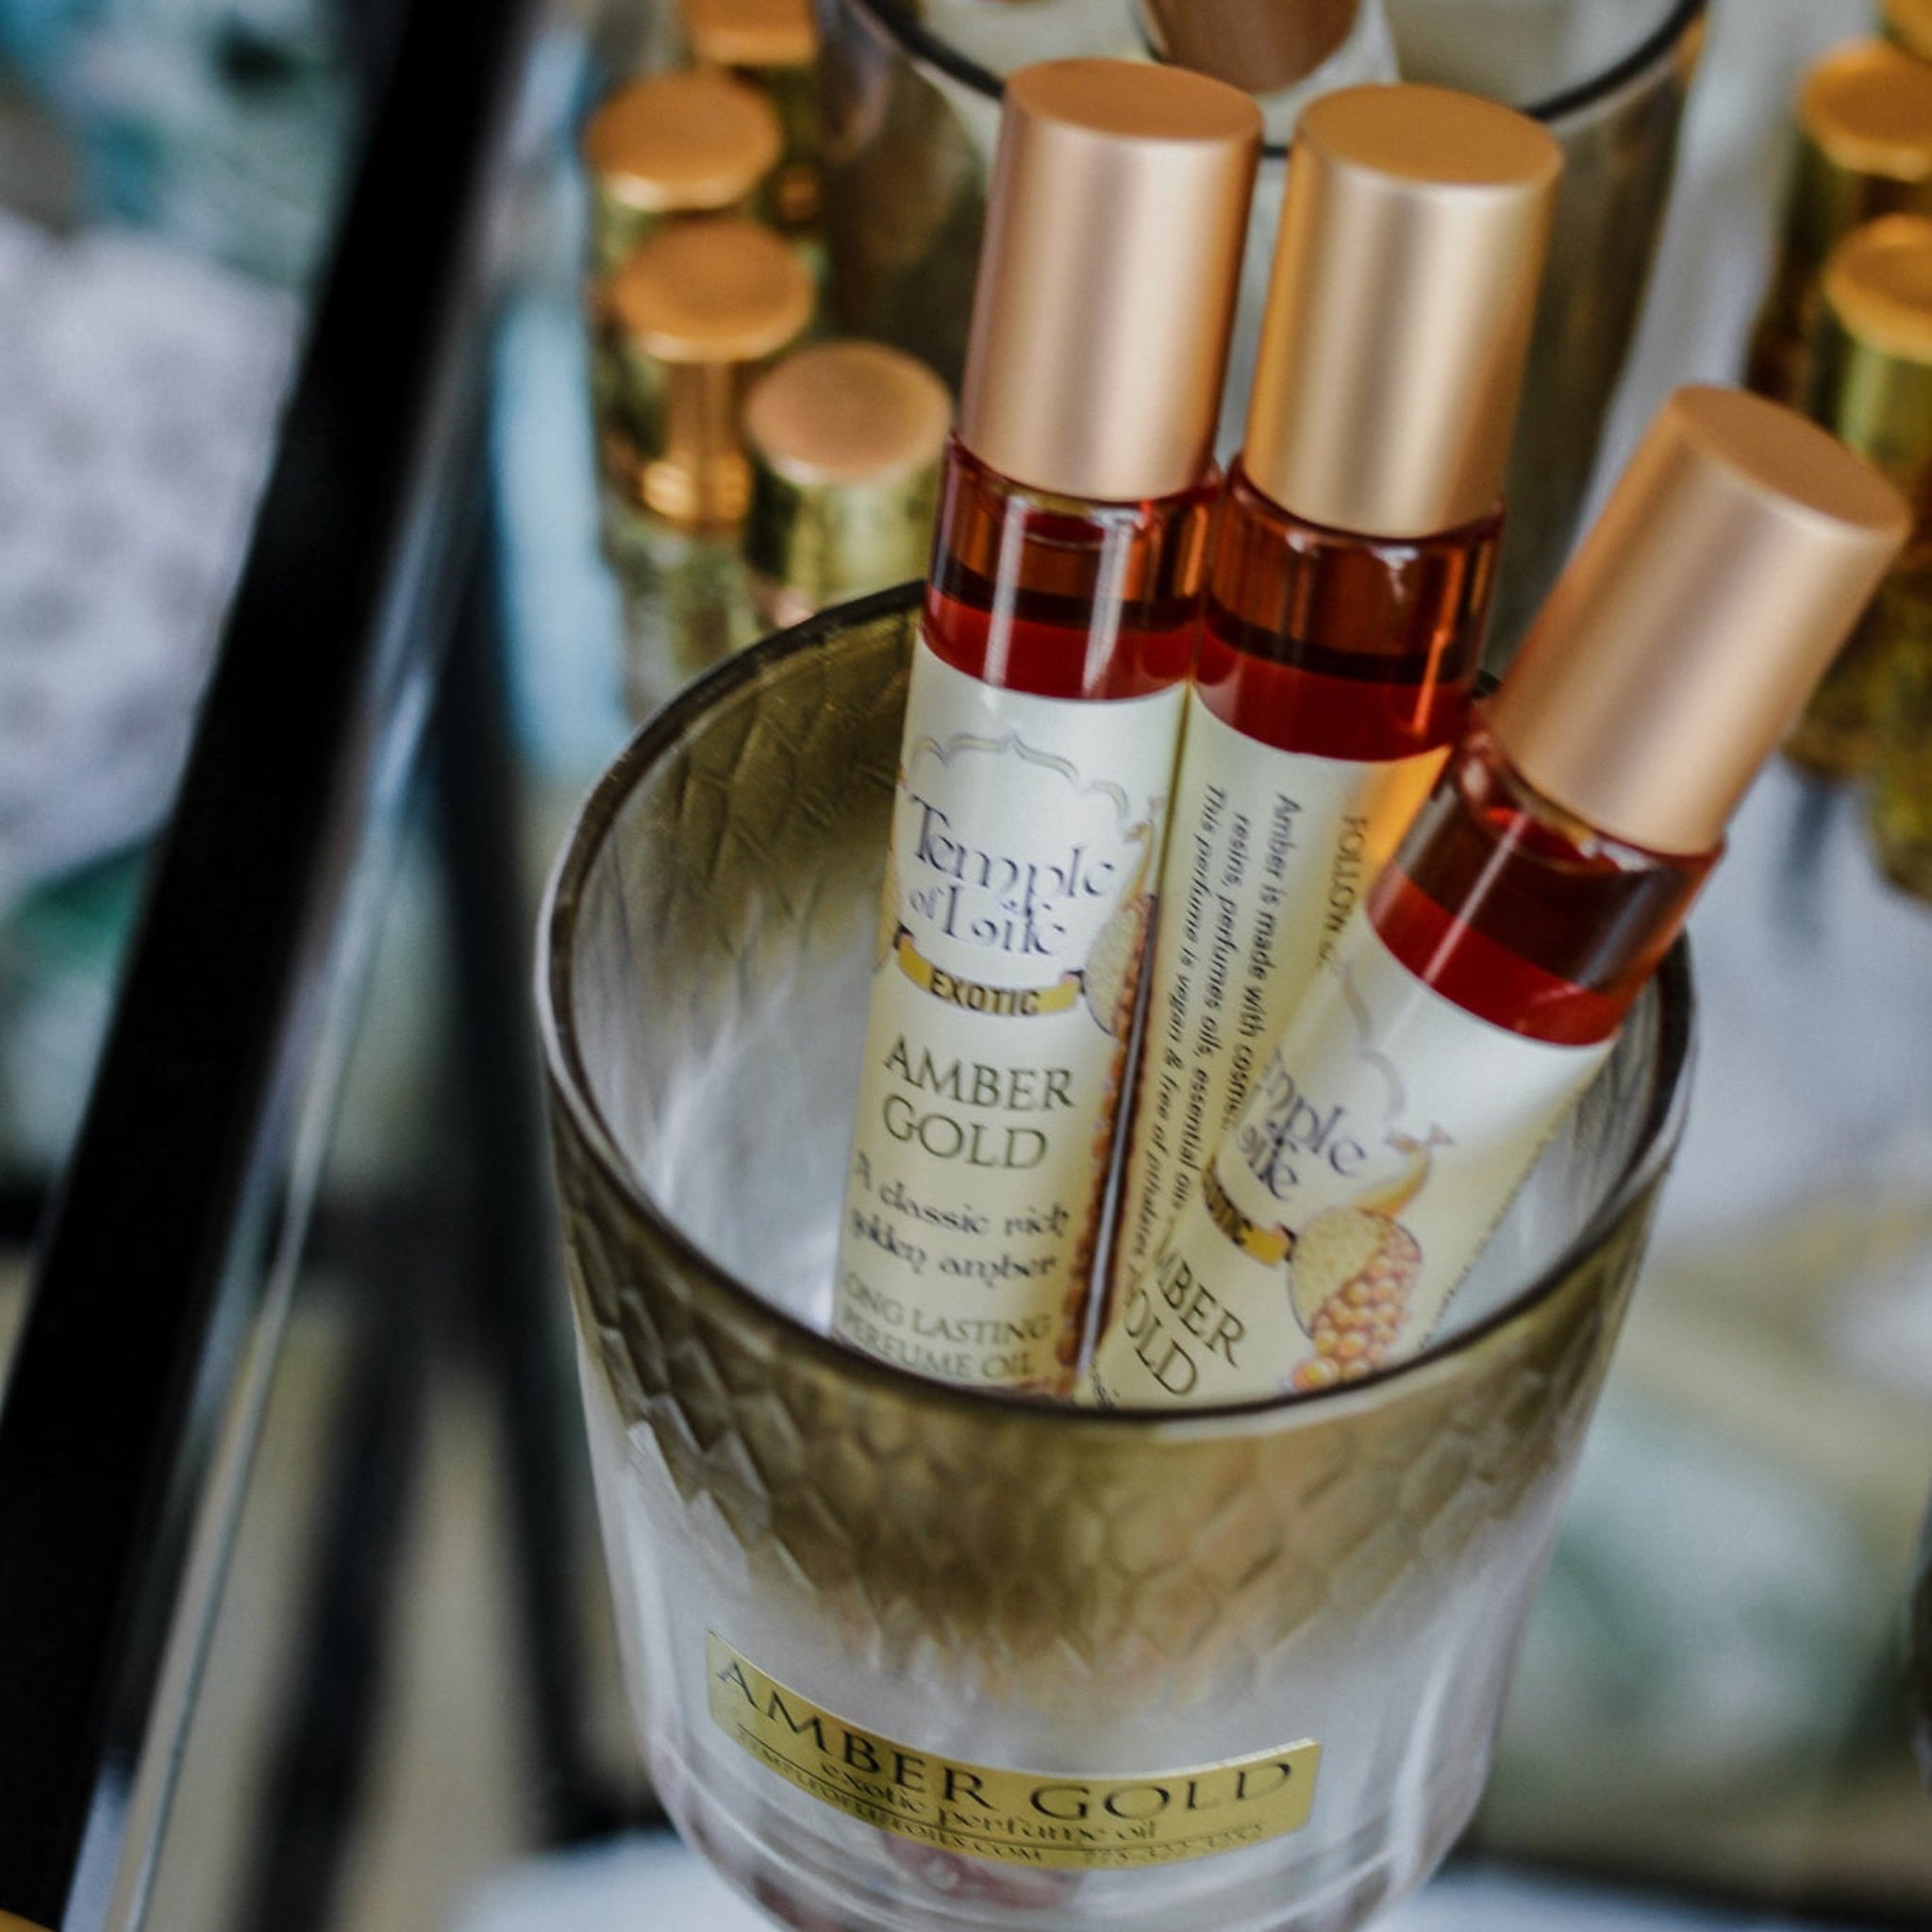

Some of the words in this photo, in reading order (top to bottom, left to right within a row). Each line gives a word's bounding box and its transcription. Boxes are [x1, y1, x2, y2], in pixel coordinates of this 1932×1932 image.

[1203, 783, 1228, 834] This
[1262, 792, 1303, 875] Amber
[908, 793, 1115, 910] Temple
[1185, 833, 1214, 945] perfume
[1259, 884, 1288, 907] is
[1180, 946, 1201, 971] is
[1205, 891, 1240, 1009] perfumes
[1246, 909, 1278, 980] made
[930, 965, 1040, 1017] EXOTIC
[1167, 974, 1191, 1043] vegan
[1237, 984, 1268, 1038] with
[883, 1034, 1075, 1111] AMBER
[1162, 1047, 1185, 1072] &
[1156, 1075, 1179, 1117] free
[1180, 1071, 1211, 1172] essential
[883, 1093, 1048, 1170] GOLD
[1150, 1122, 1171, 1156] of
[880, 1181, 991, 1236] classic
[939, 1251, 1058, 1290] amber
[911, 1305, 1052, 1349] LASTING
[1124, 1288, 1198, 1396] OLD
[1155, 1251, 1245, 1369] BER
[717, 1661, 996, 1811] AMBER
[1029, 1761, 1292, 1822] GOLD
